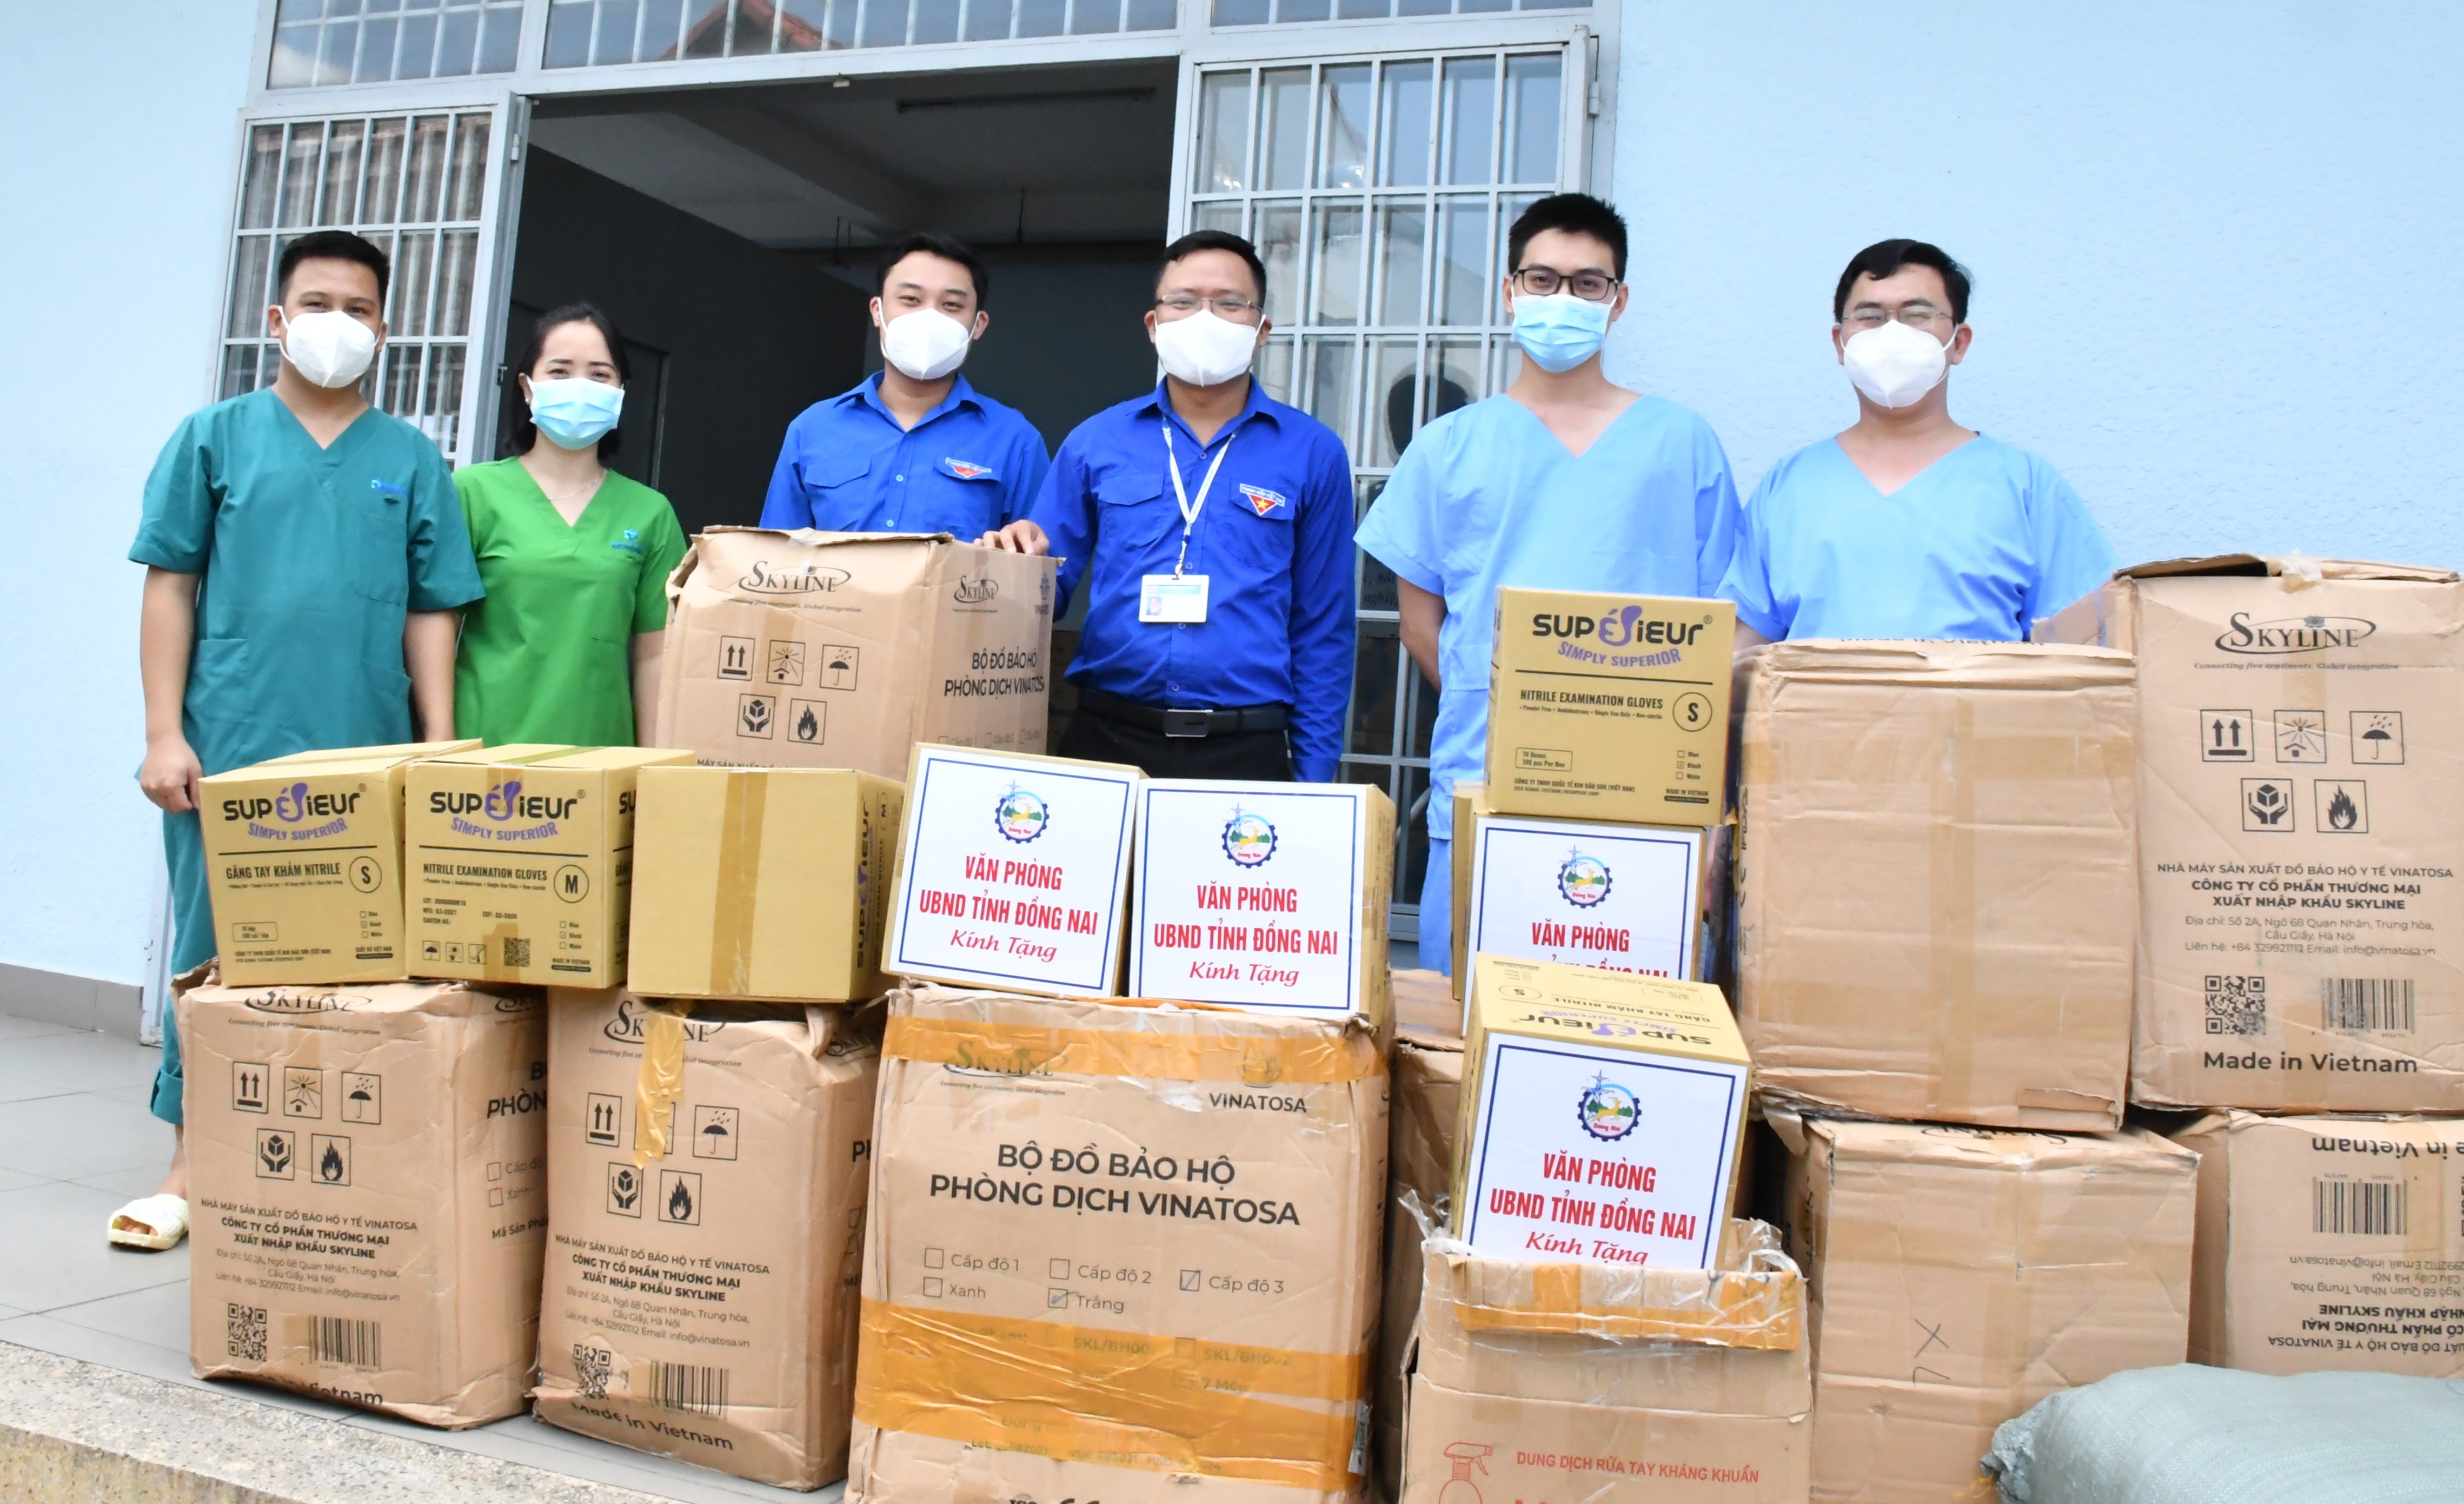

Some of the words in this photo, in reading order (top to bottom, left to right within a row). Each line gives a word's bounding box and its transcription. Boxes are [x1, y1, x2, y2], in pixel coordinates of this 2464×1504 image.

[748, 561, 837, 592] SKYLINE
[2230, 612, 2359, 647] SKYLINE
[1558, 641, 1606, 666] SIMPLY
[1611, 648, 1682, 667] SUPERIOR
[944, 674, 987, 697] PHÒNG
[1520, 690, 1556, 701] NITRILE
[1559, 692, 1623, 706] EXAMINATION
[1627, 697, 1662, 708] GLOVES
[1688, 703, 1698, 722] S
[248, 823, 287, 840] SIMPLY
[291, 818, 348, 840] SUPERIOR
[451, 817, 493, 839] SIMPLY
[497, 821, 558, 840] SUPERIOR
[361, 866, 371, 884] S
[423, 863, 454, 874] NITRILE
[457, 865, 512, 878] EXAMINATION
[515, 869, 547, 880] GLOVES
[565, 874, 578, 894] M
[966, 853, 999, 882] VĂN
[1003, 860, 1062, 890] PHÒNG
[1197, 880, 1231, 909] VĂN
[1237, 886, 1297, 912] PHÒNG
[2191, 878, 2232, 890] CÔNG
[2236, 881, 2254, 891] TY
[2259, 878, 2279, 891] CỔ
[2283, 879, 2323, 892] PHẦN
[2328, 882, 2389, 893] THƯƠNG
[2394, 884, 2420, 895] MẠI
[920, 889, 966, 917] UBND
[972, 889, 1010, 923] TỈNH
[1014, 898, 1062, 930] ĐỒNG
[1067, 909, 1098, 935] NAI
[2213, 893, 2251, 906] XUẤT
[2256, 895, 2296, 909] NHẬP
[2301, 895, 2341, 908] KHẨU
[2346, 898, 2405, 909] SKYLINE
[950, 929, 999, 951] Kính
[1008, 937, 1057, 962] Tặng
[1154, 923, 1201, 949] UBND
[1207, 917, 1246, 950] TỈNH
[1253, 923, 1300, 953] ĐỒNG
[1307, 930, 1337, 955] NAI
[1532, 918, 1565, 947] VĂN
[1571, 925, 1629, 952] PHÒNG
[1189, 961, 1239, 979] Kính
[1249, 964, 1299, 986] Tặng
[614, 1001, 709, 1042] SKNE
[2204, 1051, 2272, 1069] Made
[2280, 1051, 2302, 1070] in
[2310, 1052, 2417, 1072] Vietnam
[1209, 1093, 1307, 1113] VINATOSA
[2312, 1137, 2419, 1159] Vietnam
[2427, 1142, 2447, 1160] in
[998, 1140, 1042, 1176] BỘ
[1050, 1143, 1099, 1174] ĐỒ
[1108, 1147, 1177, 1180] BẢO
[1187, 1155, 1234, 1190] HỘ
[1544, 1149, 1583, 1182] VĂN
[1588, 1157, 1656, 1192] PHÒNG
[930, 1172, 1042, 1205] PHÒNG
[1052, 1184, 1128, 1214] DỊCH
[1138, 1191, 1300, 1225] VINATOSA
[1490, 1188, 1544, 1218] UBND
[1551, 1192, 1596, 1226] TỈNH
[1600, 1200, 1655, 1235] ĐỒNG
[1660, 1211, 1696, 1240] NAI
[572, 1253, 596, 1267] CÔNG
[599, 1259, 610, 1269] TY
[613, 1261, 626, 1273] CỔ
[628, 1264, 659, 1278] PHẦN
[662, 1270, 712, 1285] THƯƠNG
[716, 1276, 740, 1289] MẠI
[1078, 1264, 1111, 1282] Cấp
[1115, 1268, 1137, 1282] độ
[1142, 1270, 1151, 1283] 2
[582, 1270, 607, 1283] XUẤT
[609, 1276, 636, 1289] NHẬP
[640, 1281, 672, 1295] KHẨU
[675, 1287, 725, 1301] SKYLINE
[949, 1284, 986, 1298] Xanh
[1209, 1275, 1243, 1293] Cấp
[1247, 1278, 1269, 1292] độ
[1273, 1280, 1283, 1293] 3
[649, 1420, 733, 1449] Vietnam
